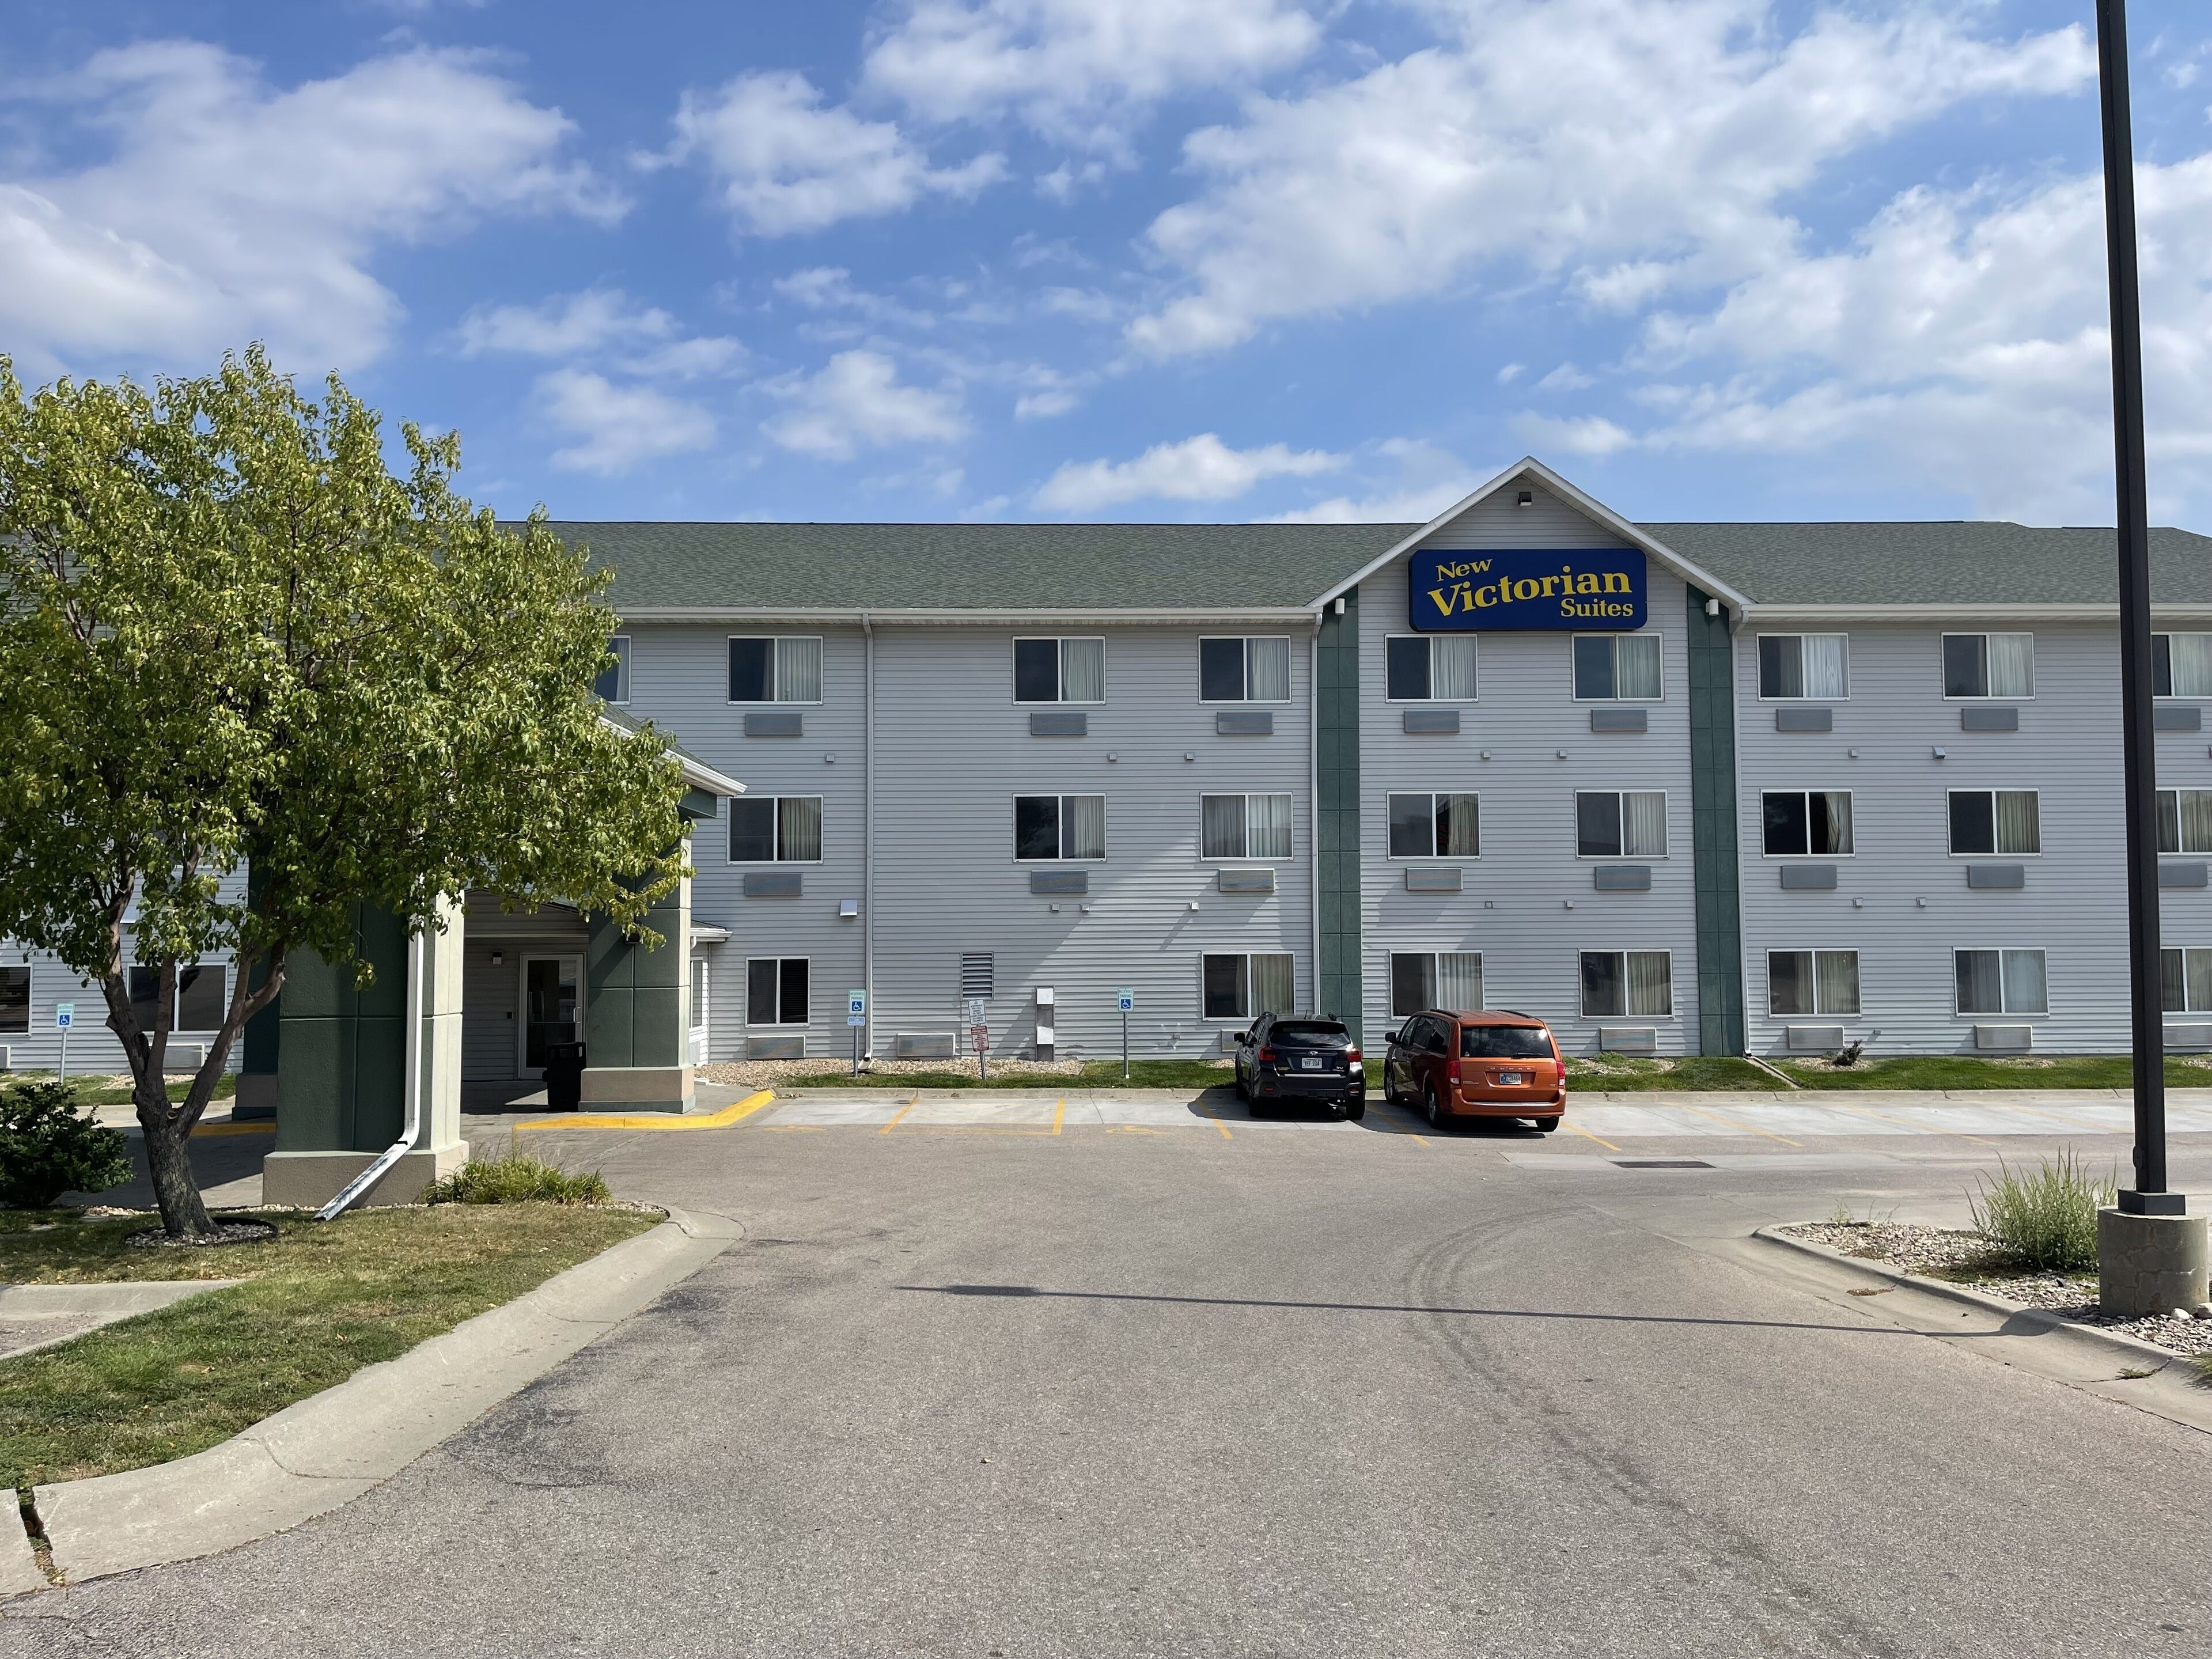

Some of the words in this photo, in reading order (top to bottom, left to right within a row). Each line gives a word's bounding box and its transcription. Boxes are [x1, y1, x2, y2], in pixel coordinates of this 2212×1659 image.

[1435, 559, 1493, 582] New
[1427, 565, 1633, 616] Victorian
[1560, 597, 1634, 617] Suites
